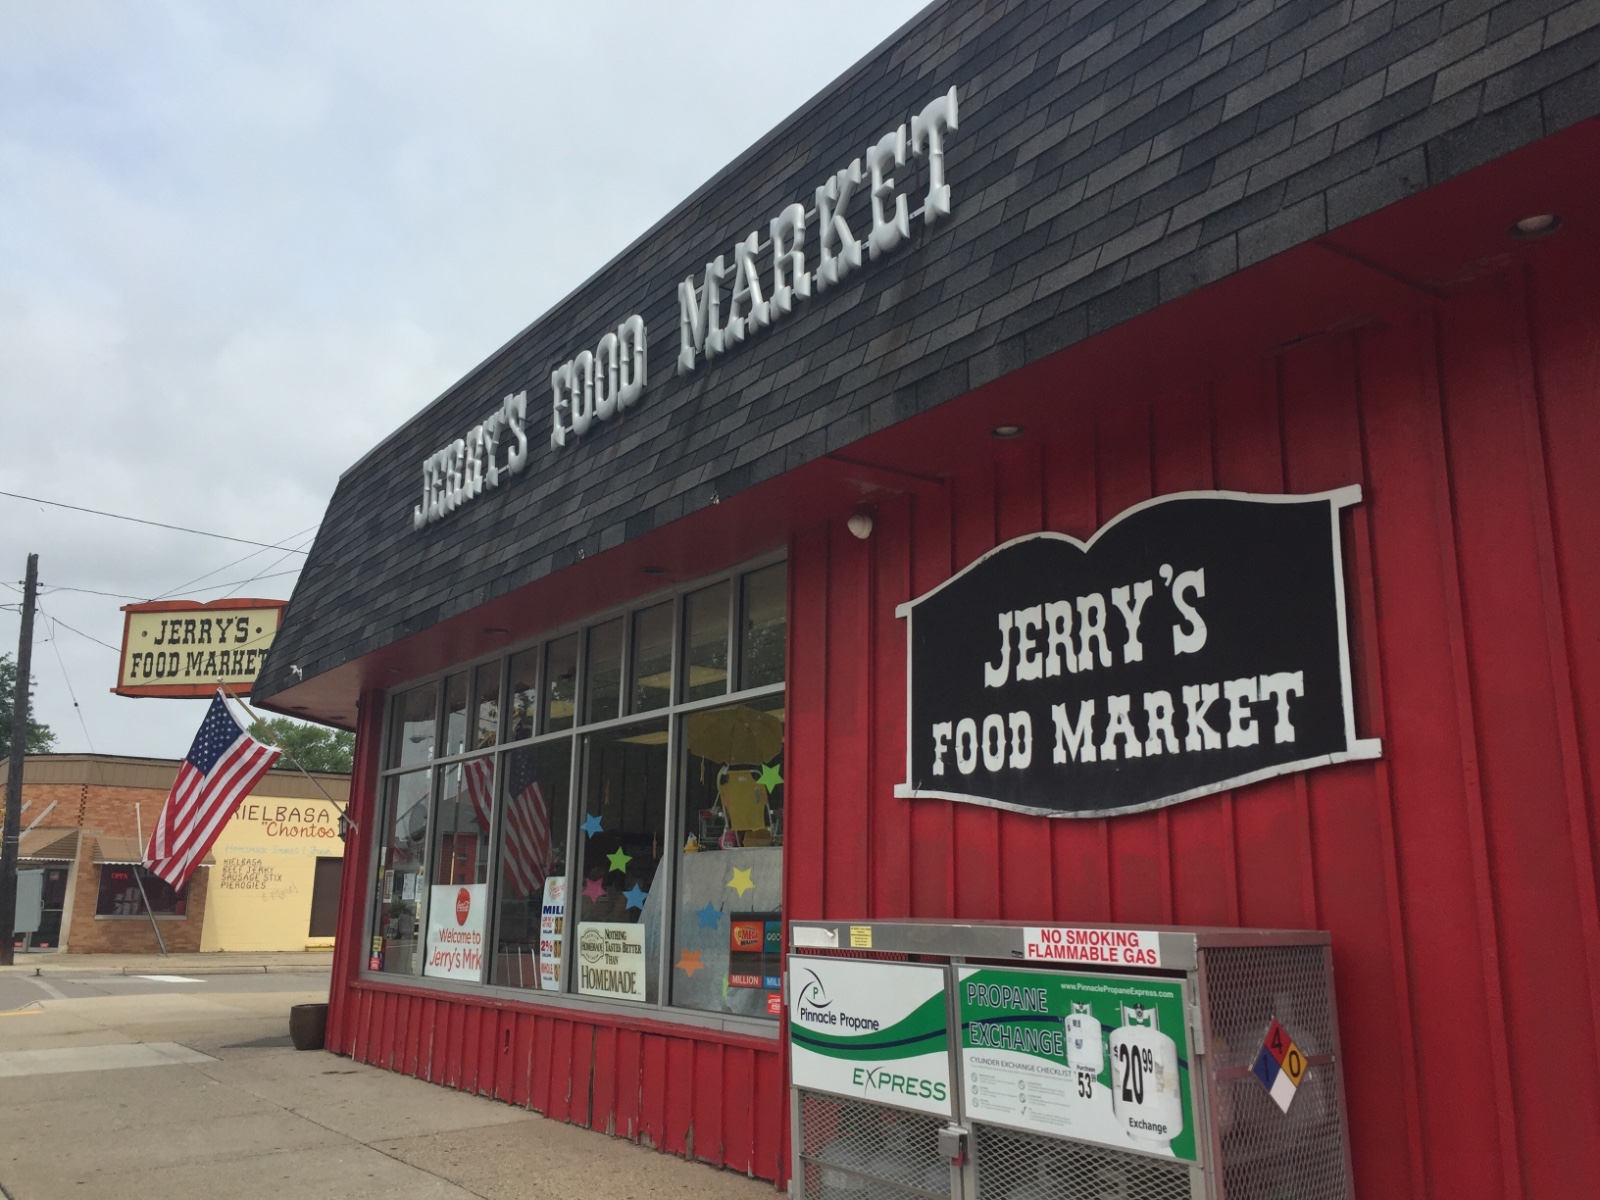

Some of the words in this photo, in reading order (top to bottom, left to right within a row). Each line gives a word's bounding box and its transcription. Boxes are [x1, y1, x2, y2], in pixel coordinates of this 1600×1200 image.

[413, 390, 529, 532] JERRY'S
[550, 314, 647, 452] FOOD
[677, 85, 959, 376] MARKET
[154, 616, 250, 645] JERRY'S
[984, 563, 1207, 689] JERRY'S
[131, 651, 180, 678] FOOD
[932, 710, 1033, 776] FOOD
[1051, 670, 1304, 764] MARKET
[223, 858, 262, 867] KIELBASA
[221, 874, 259, 882] SAUSAGE
[264, 874, 282, 882] STIX
[439, 928, 471, 944] Welcome
[472, 931, 481, 944] to
[1041, 929, 1062, 944] NO
[1066, 930, 1139, 947] SMOKING
[429, 946, 461, 972] Jerry's
[463, 947, 482, 970] Mrk
[1028, 944, 1119, 962] FLAMMABLE
[1123, 948, 1157, 965] GAS
[581, 965, 637, 995] HOMEMADE
[732, 974, 759, 985] MILLION
[1060, 983, 1174, 998] www.PinnaclePropaneExpress.com
[813, 987, 819, 999] P
[967, 982, 1049, 1013] PROPANE
[800, 1007, 837, 1025] Pinnacle
[840, 1012, 880, 1031] Propane
[969, 1021, 1064, 1056] EXCHANGE
[1271, 1027, 1283, 1054] 4
[970, 1056, 1000, 1067] CYLINDER
[1001, 1060, 1035, 1073] EXCHANGE
[1036, 1065, 1072, 1077] CHECKLIST
[1289, 1050, 1300, 1078] 0
[852, 1066, 947, 1101] EXPRESS
[1129, 1117, 1168, 1135] Exchange
